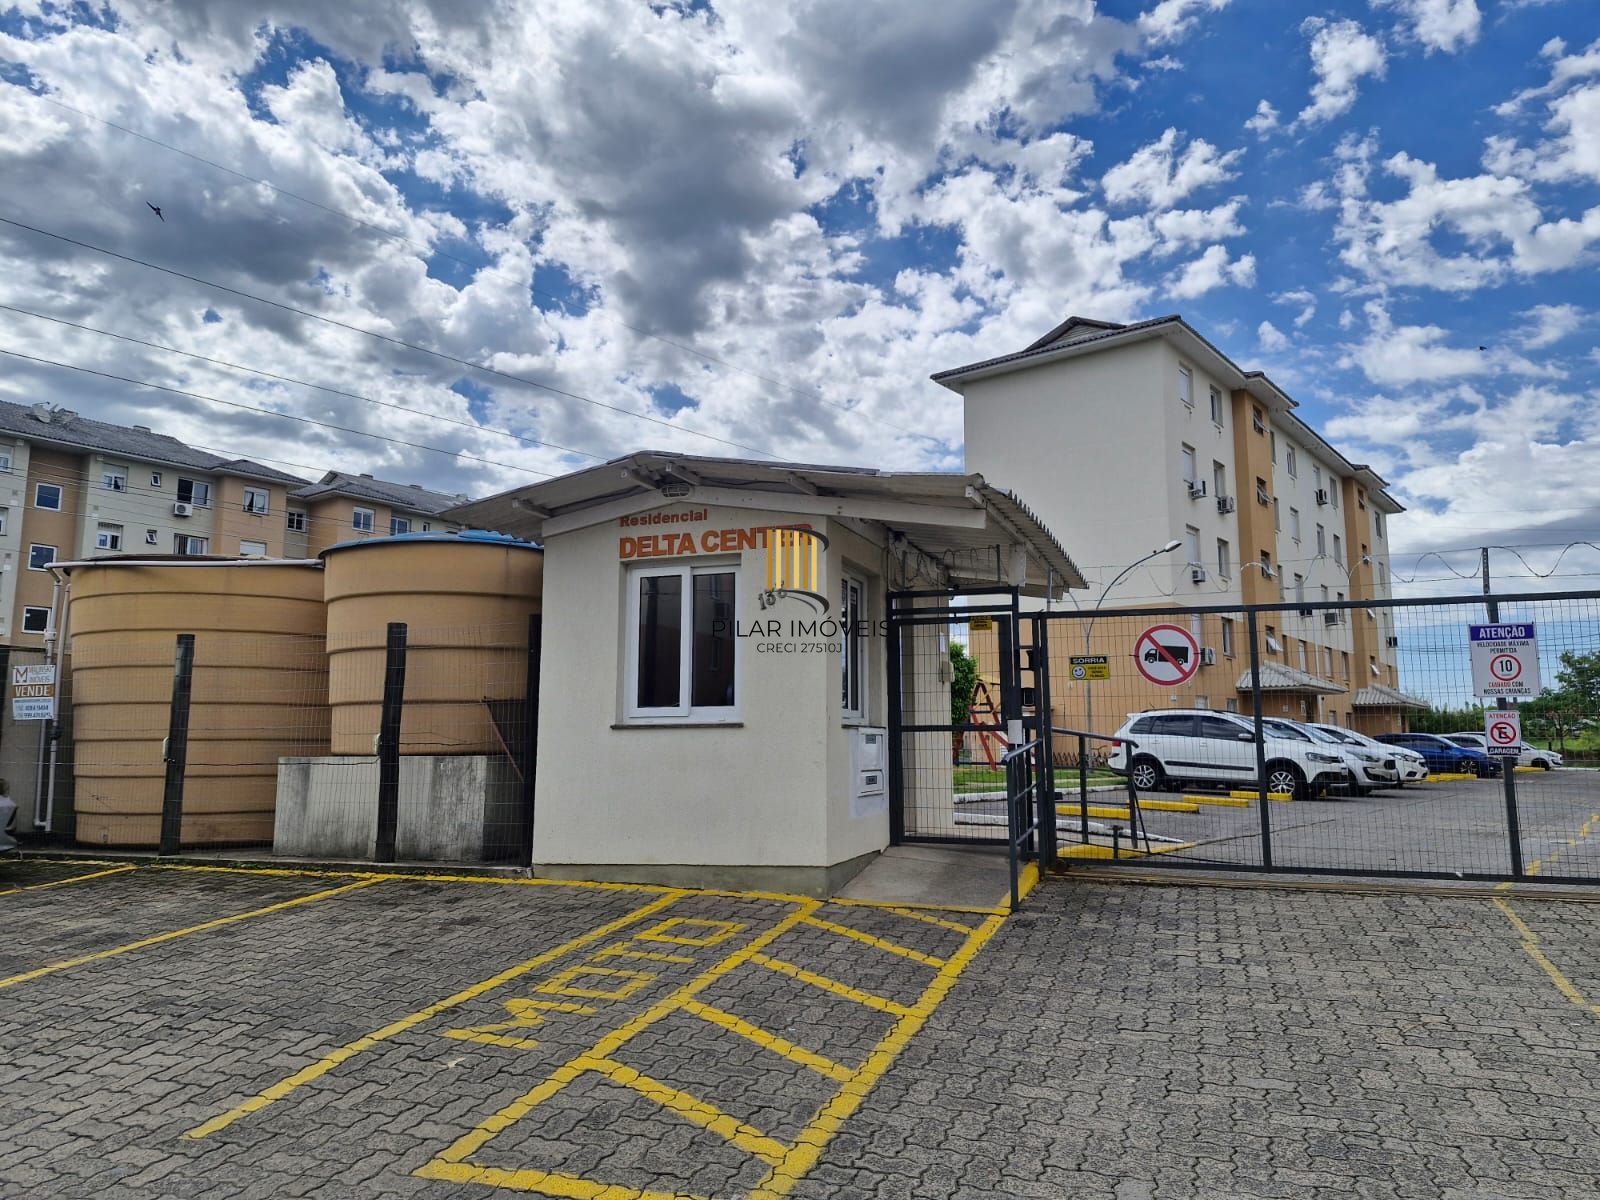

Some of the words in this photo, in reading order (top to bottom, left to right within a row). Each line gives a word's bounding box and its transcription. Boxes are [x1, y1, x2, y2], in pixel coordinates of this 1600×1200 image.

[619, 508, 708, 528] Residencial
[619, 532, 697, 559] DELTA
[1479, 625, 1526, 640] ATENÇÃO
[1499, 659, 1513, 672] 10
[15, 685, 50, 697] VENDE
[440, 917, 748, 1050] MOTO
